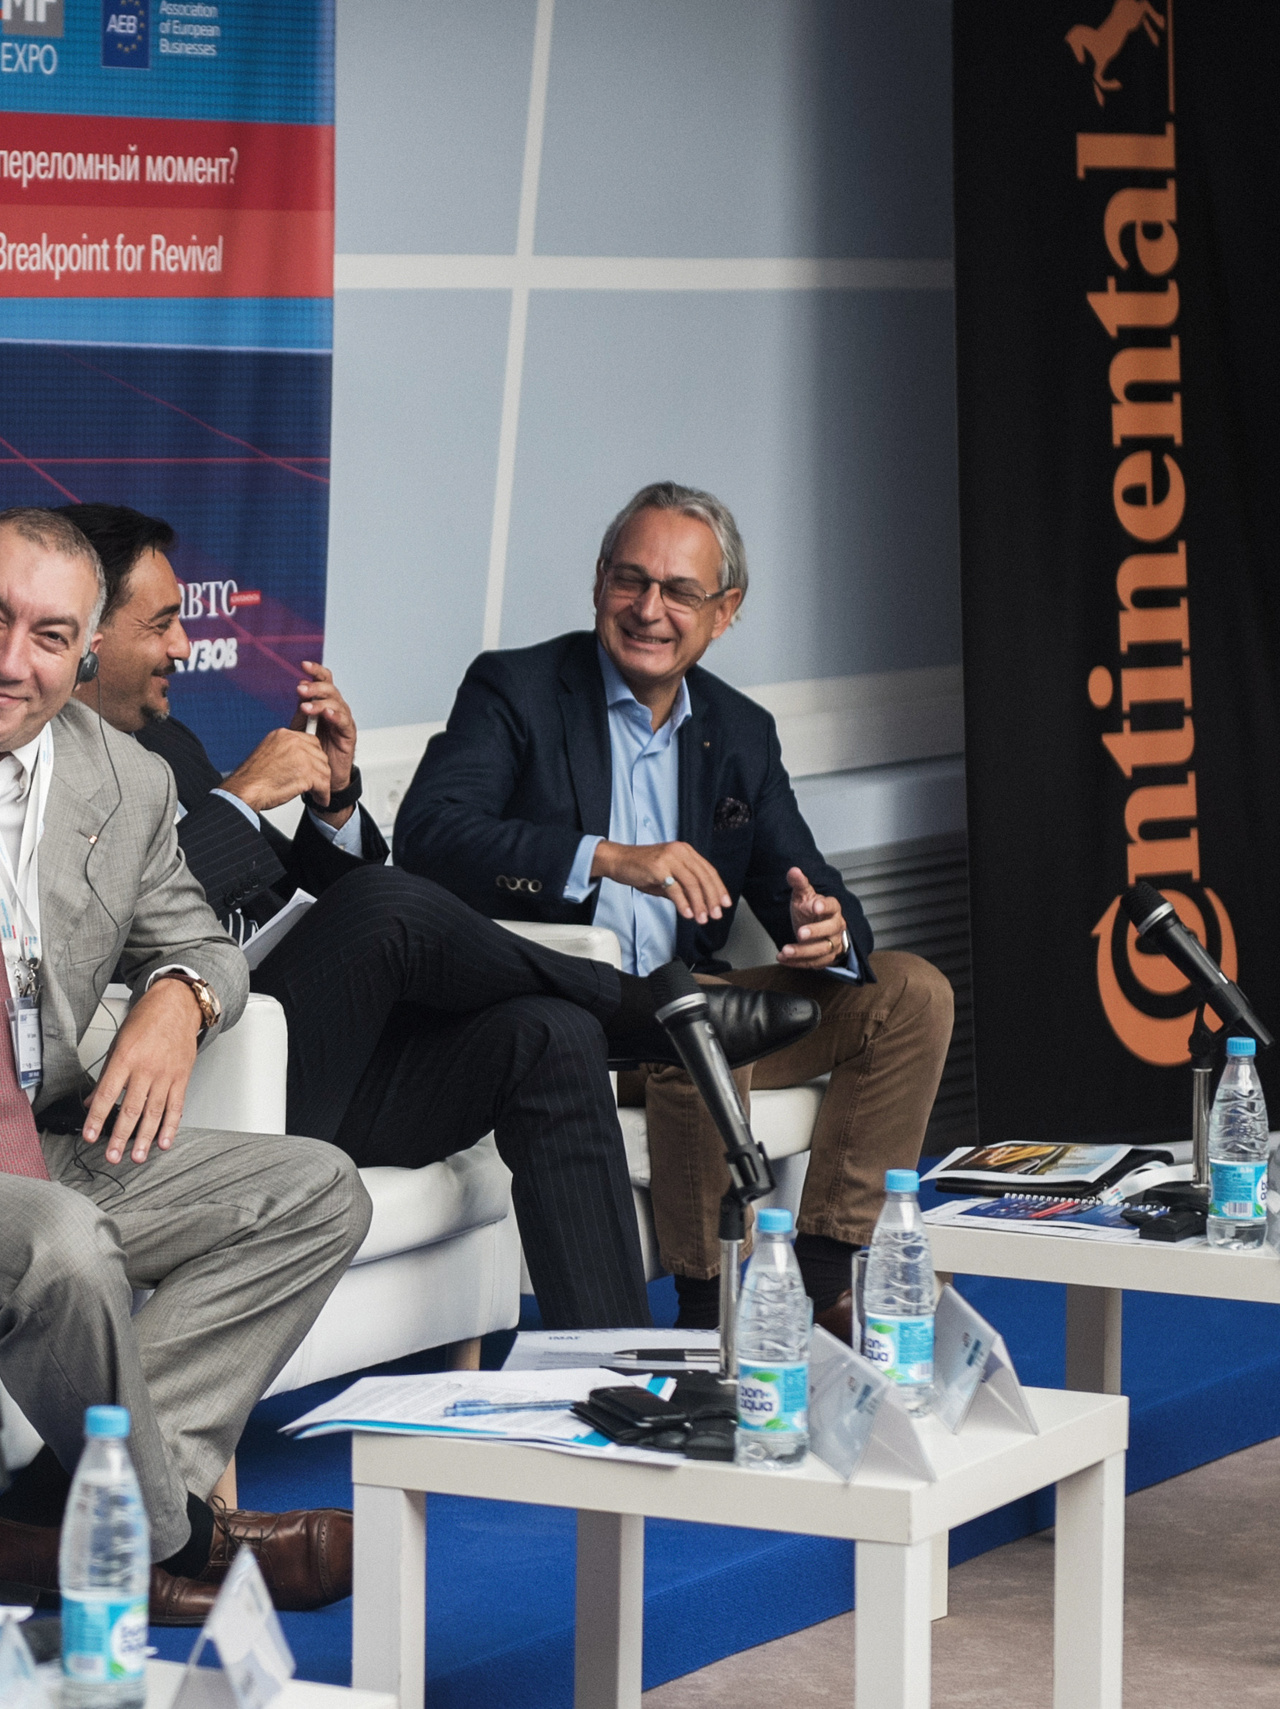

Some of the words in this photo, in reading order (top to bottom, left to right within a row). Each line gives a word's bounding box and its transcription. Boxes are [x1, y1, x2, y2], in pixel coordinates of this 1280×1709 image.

[159, 0, 219, 18] Association
[106, 14, 138, 34] AEB
[159, 20, 171, 34] of
[172, 20, 221, 38] European
[1, 42, 58, 75] EXPO
[159, 38, 217, 56] Businesses
[145, 147, 238, 184] момент?
[116, 233, 145, 272] for
[151, 234, 223, 272] Revival
[1076, 121, 1238, 1066] Continental
